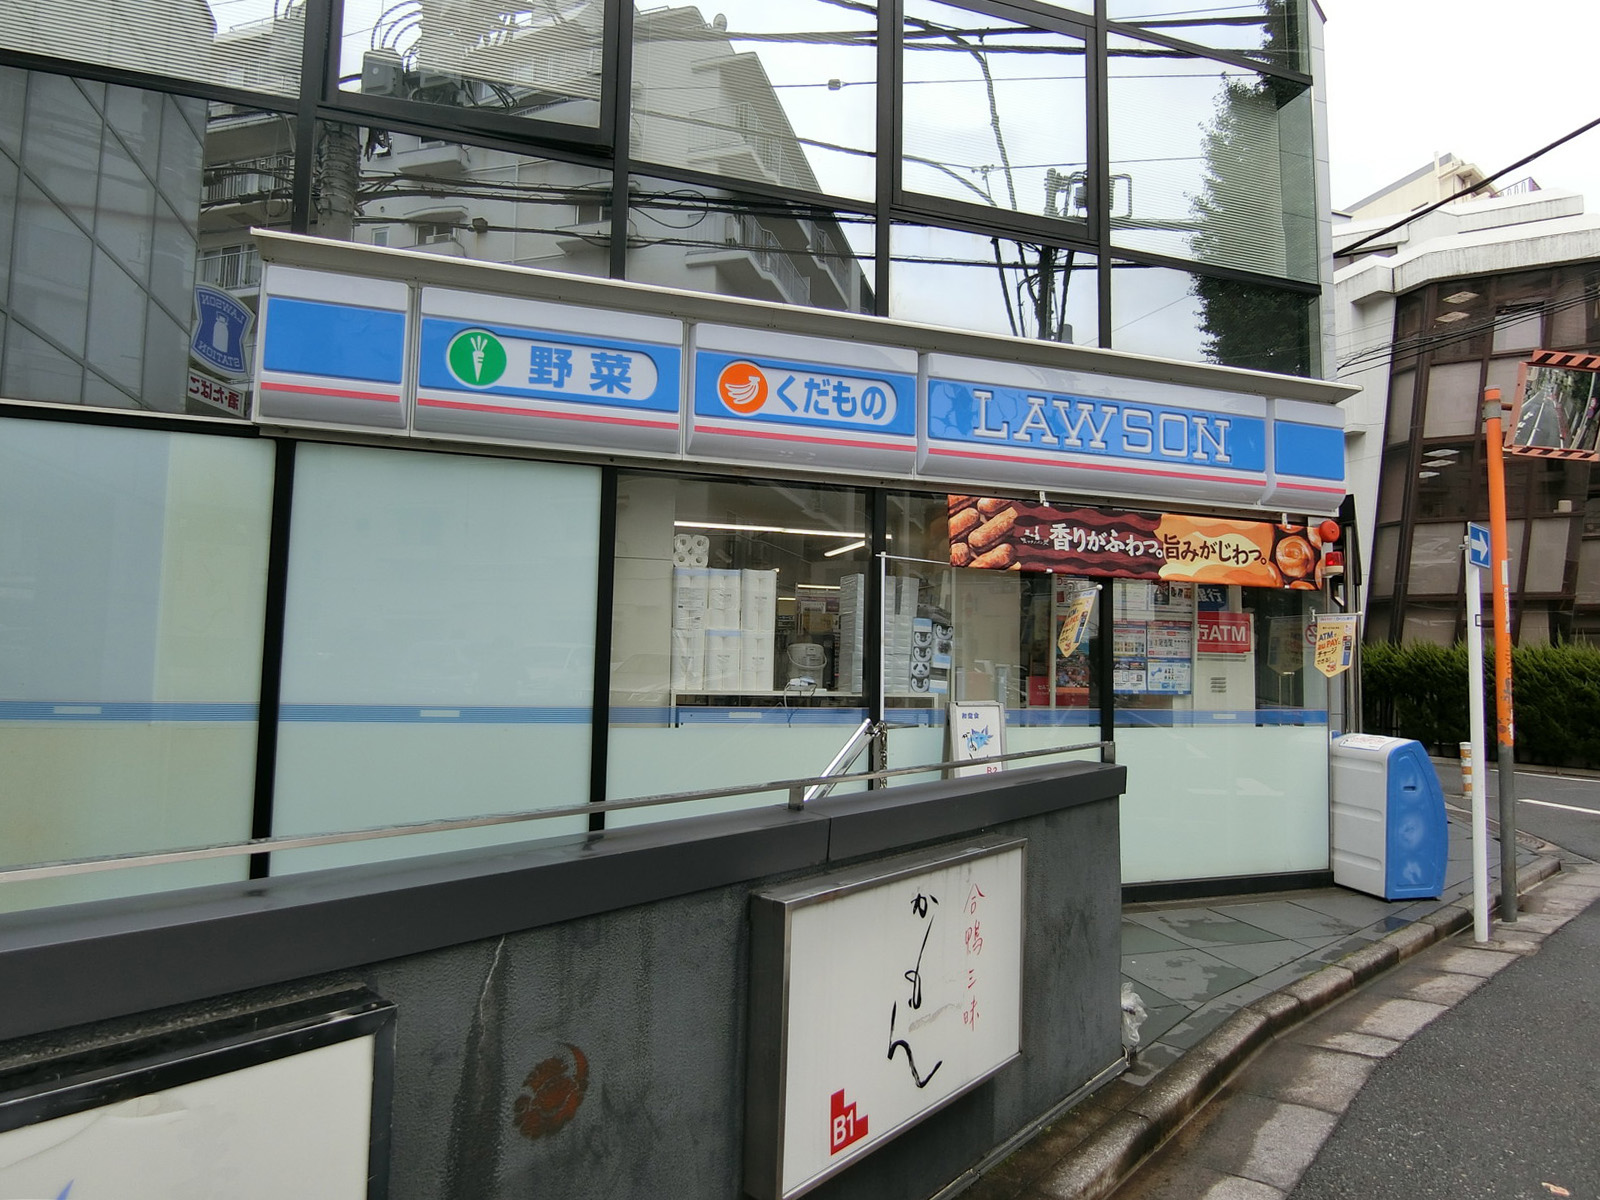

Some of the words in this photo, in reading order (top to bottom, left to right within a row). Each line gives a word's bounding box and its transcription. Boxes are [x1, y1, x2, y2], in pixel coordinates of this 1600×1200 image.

[528, 345, 632, 394] 野菜
[776, 374, 887, 420] くだもの
[973, 389, 1232, 463] LAWSON
[833, 1109, 854, 1147] B1
